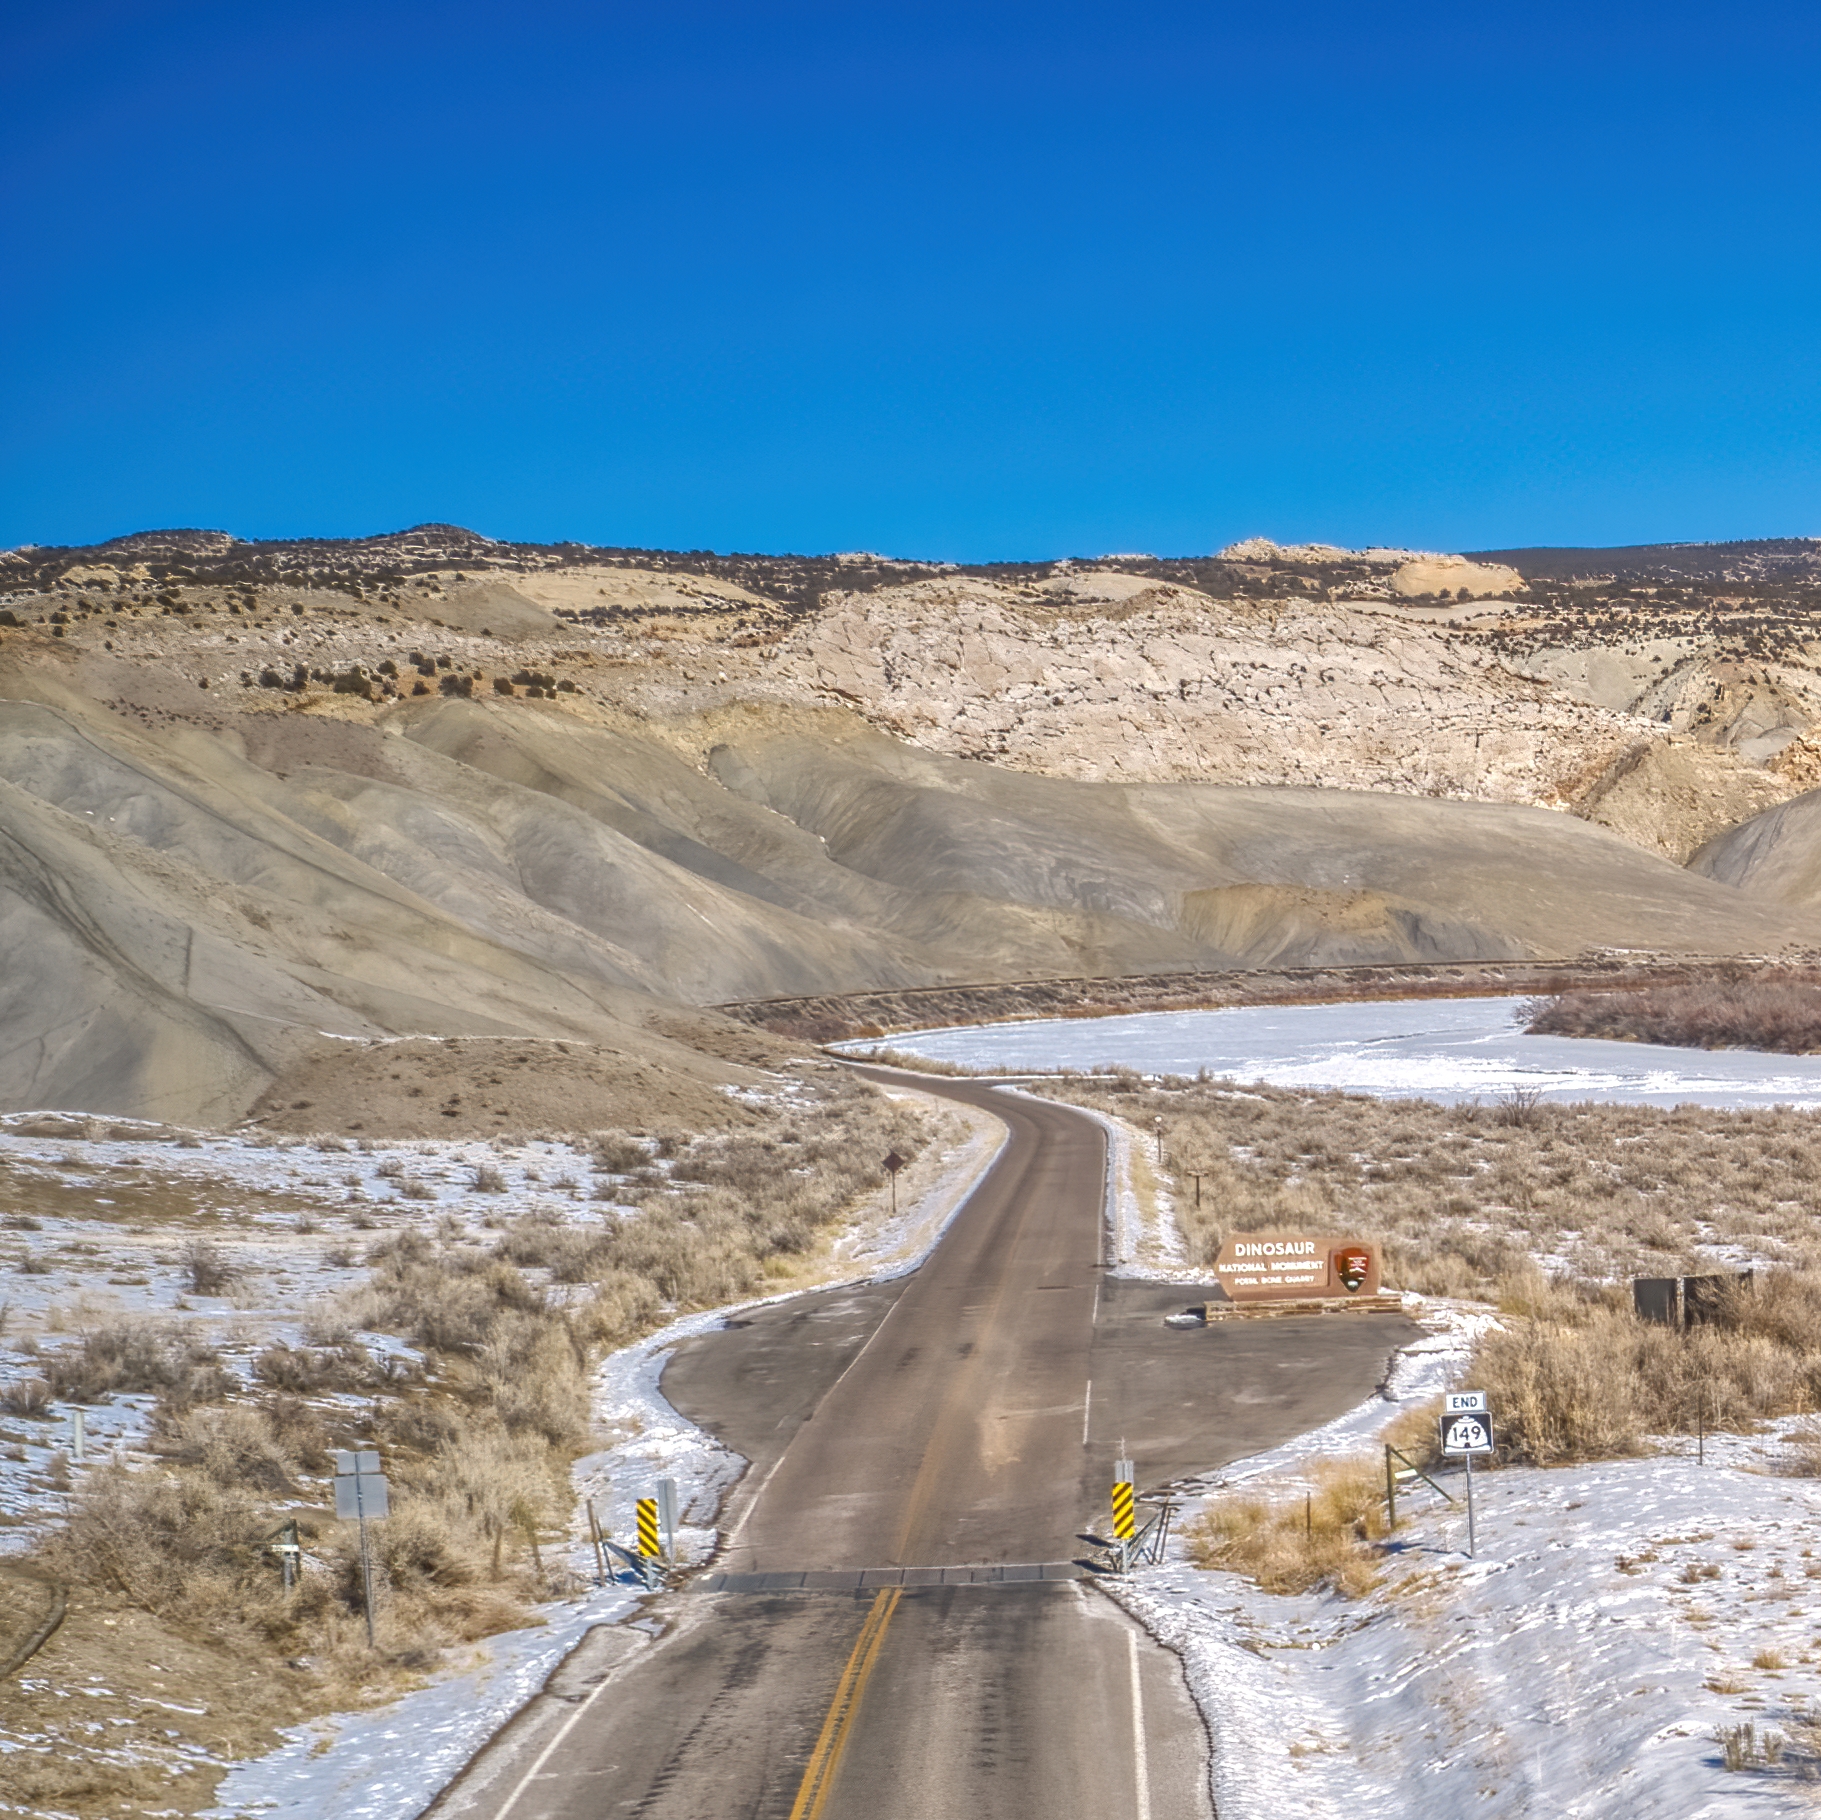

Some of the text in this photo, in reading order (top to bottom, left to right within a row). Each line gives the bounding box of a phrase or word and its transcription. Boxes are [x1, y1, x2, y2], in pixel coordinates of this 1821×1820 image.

[1235, 1241, 1315, 1257] DINOSAUR
[1218, 1260, 1325, 1273] NATIONAL MONUMENT
[1452, 1396, 1478, 1409] END
[1453, 1425, 1481, 1442] 149
